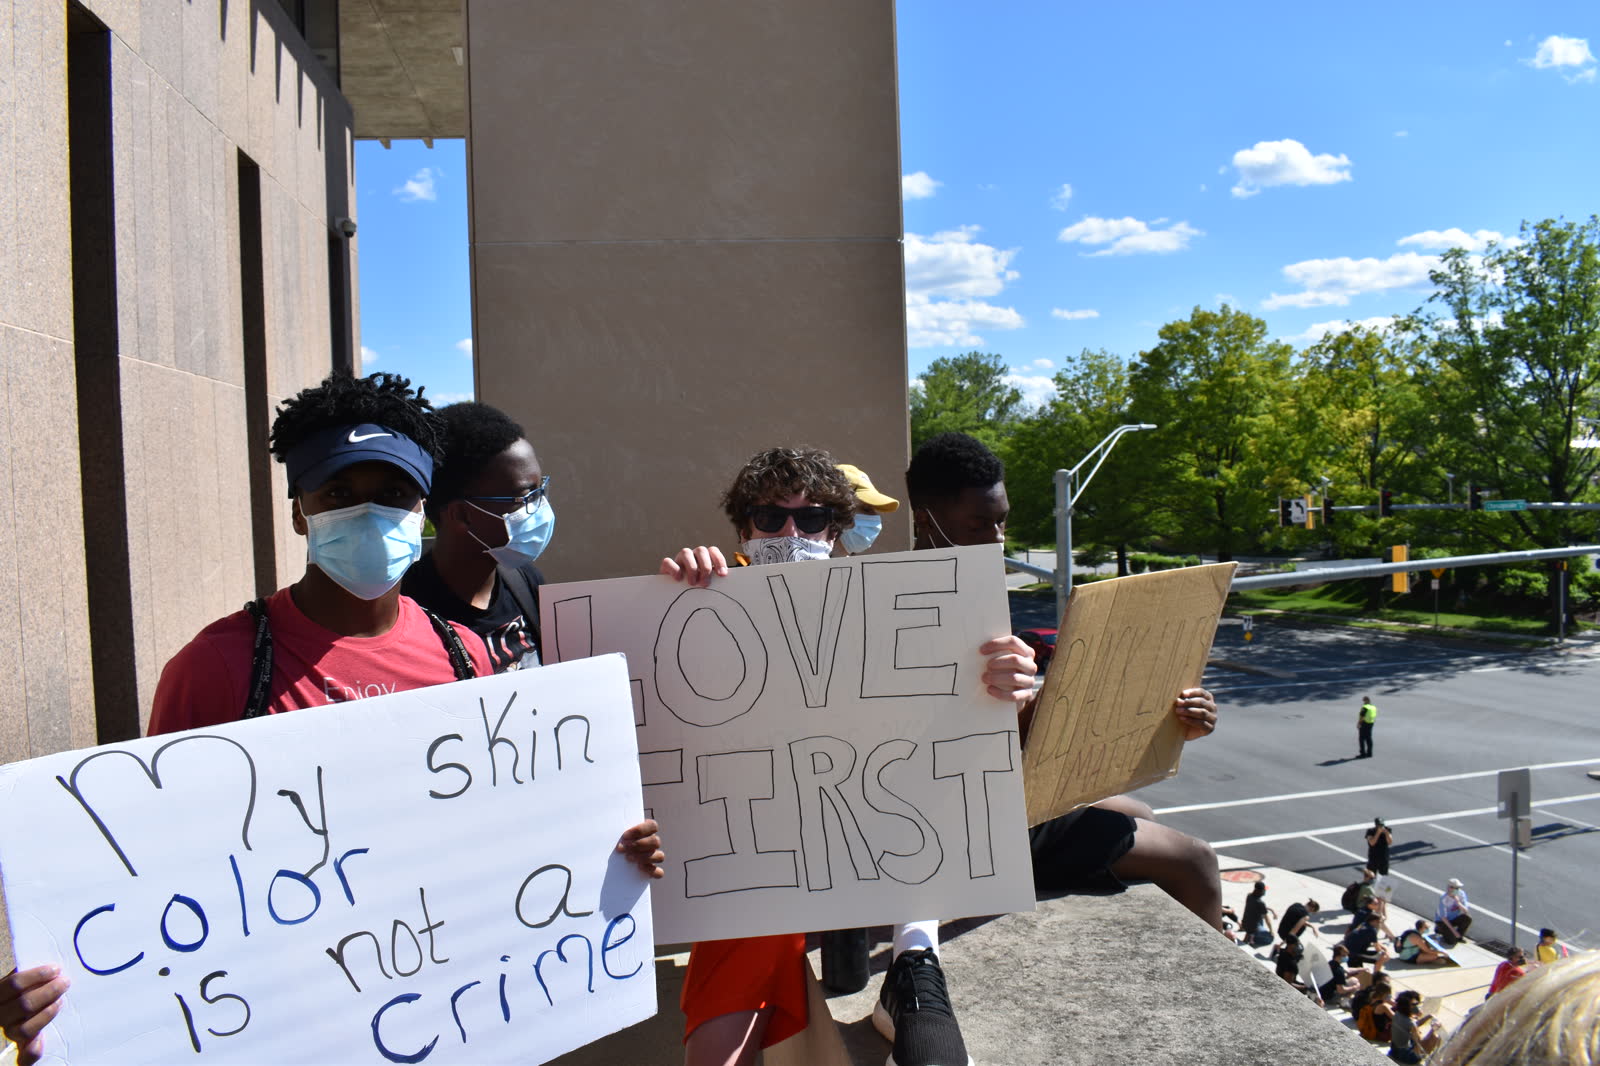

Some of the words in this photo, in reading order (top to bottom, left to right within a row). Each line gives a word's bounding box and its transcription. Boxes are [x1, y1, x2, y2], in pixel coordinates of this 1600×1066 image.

[1034, 625, 1151, 770] BLACK
[57, 734, 330, 877] My
[73, 847, 370, 976] color
[158, 965, 252, 1053] is
[326, 887, 450, 992] not
[515, 864, 594, 928] a
[370, 912, 643, 1065] crime
